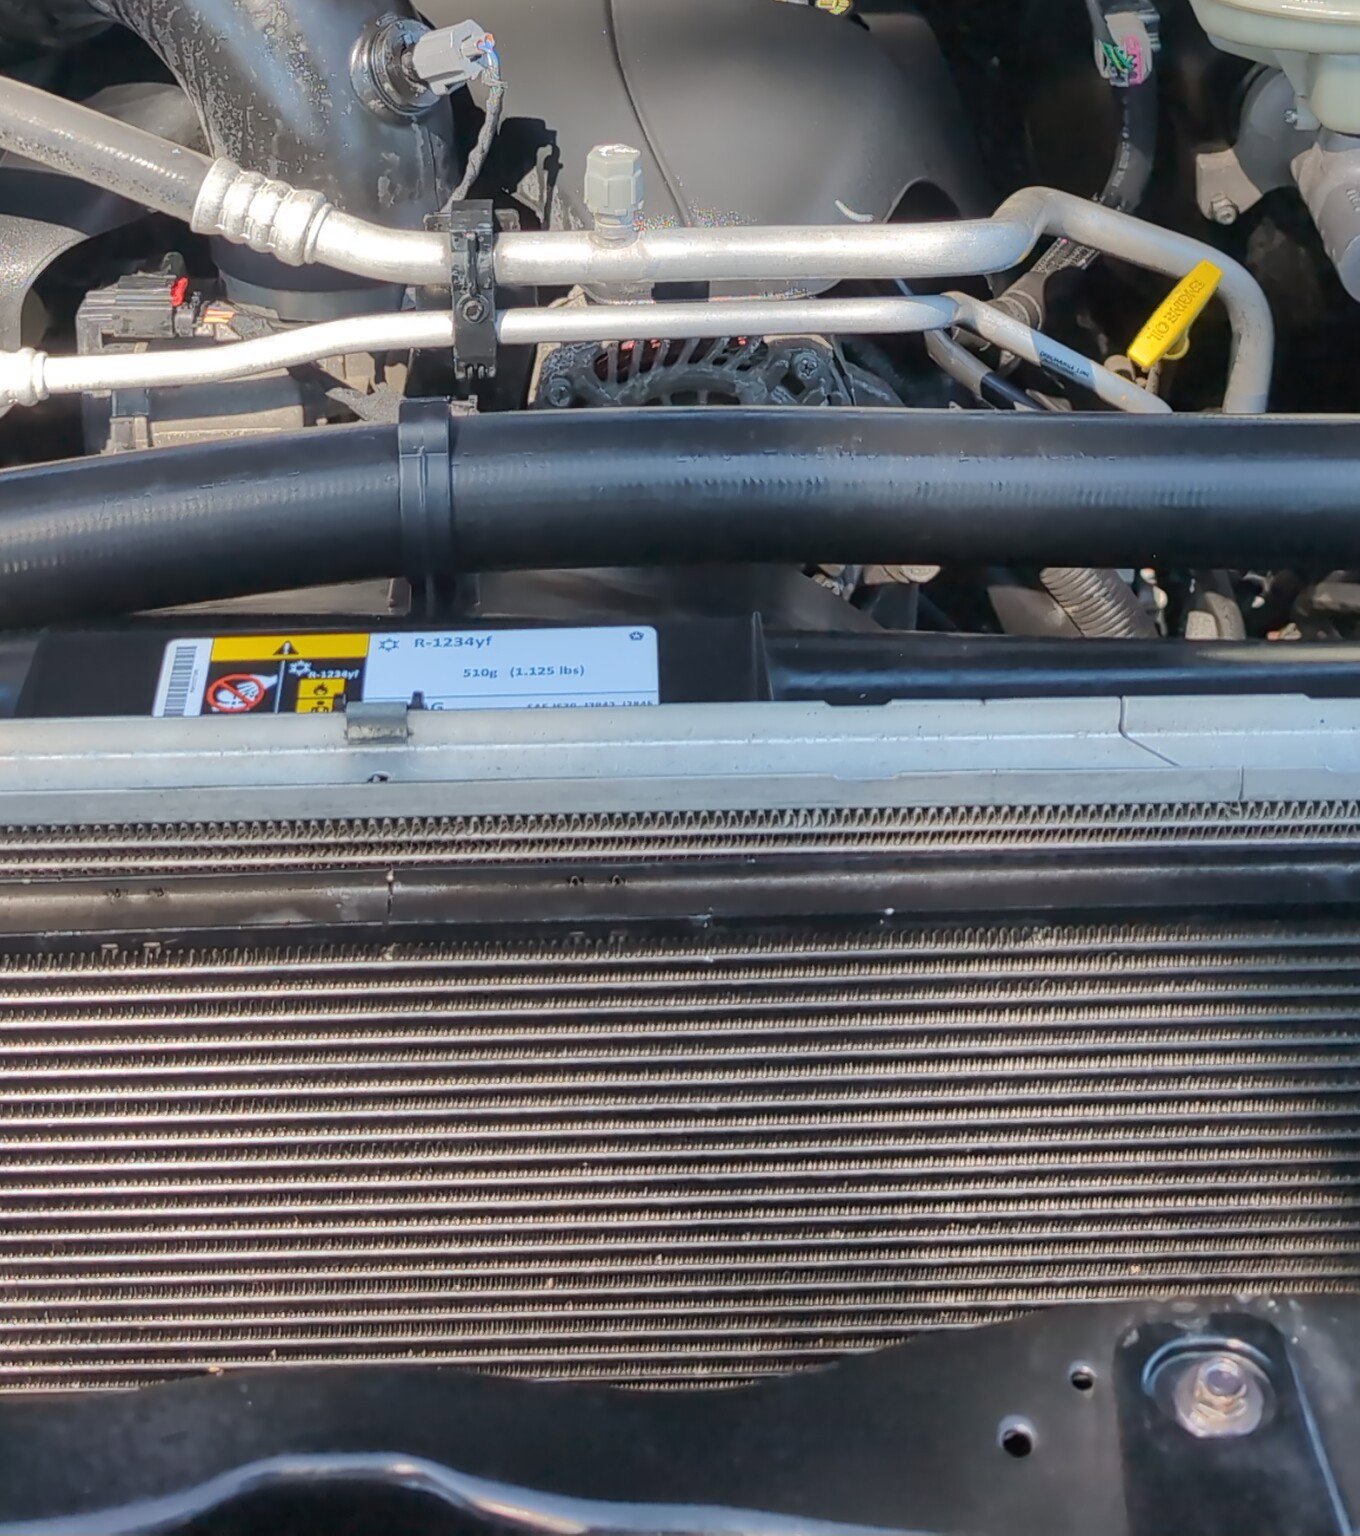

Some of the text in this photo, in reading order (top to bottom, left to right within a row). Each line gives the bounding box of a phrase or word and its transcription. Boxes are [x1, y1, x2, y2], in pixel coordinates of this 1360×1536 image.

[414, 635, 493, 650] R-1234yf
[307, 669, 361, 681] R-1234yf
[463, 665, 585, 679] 510g (1.125 lbs)
